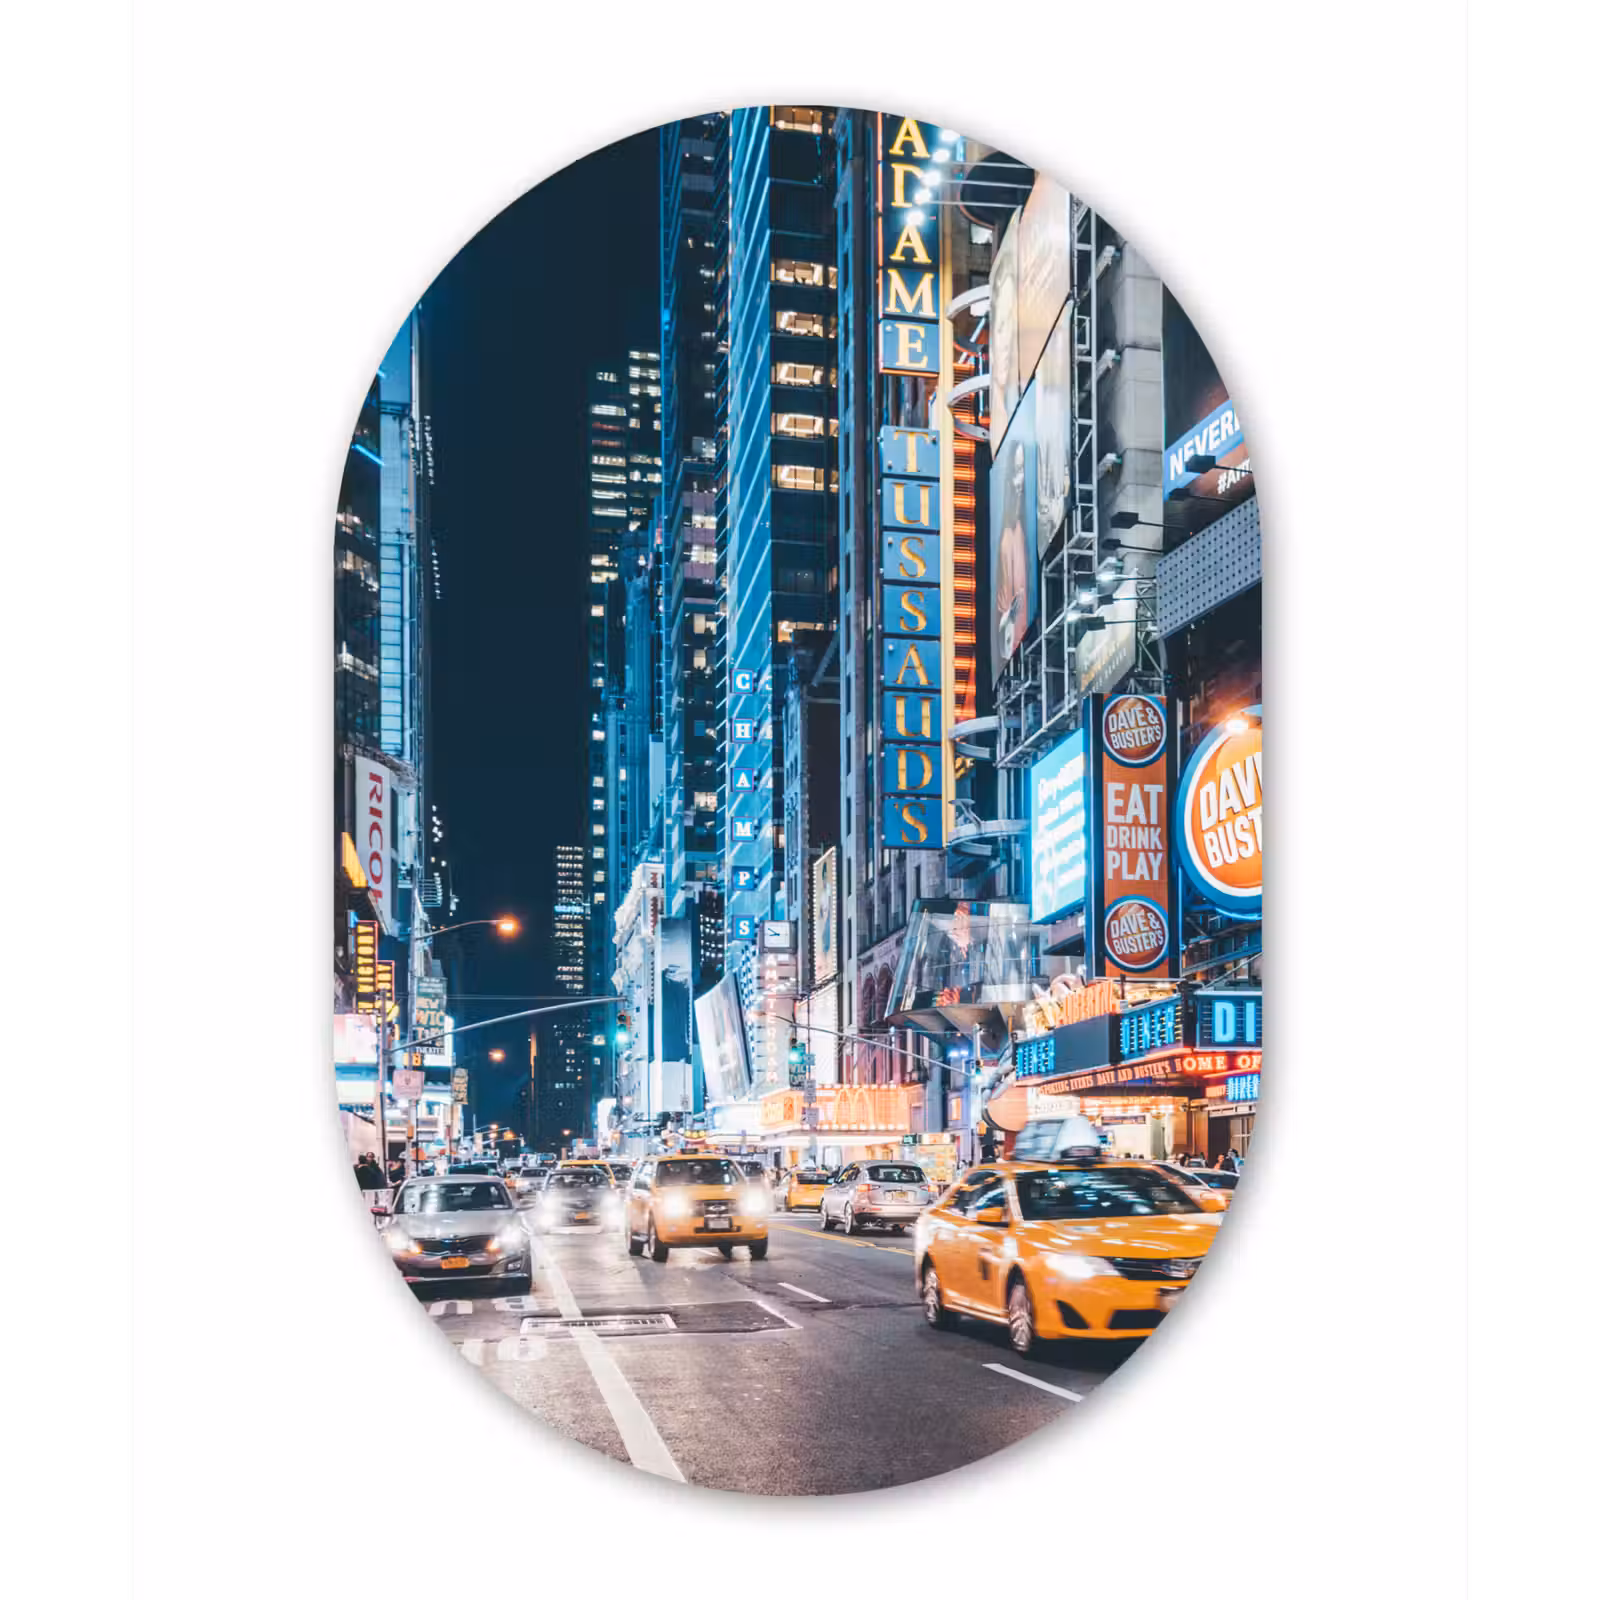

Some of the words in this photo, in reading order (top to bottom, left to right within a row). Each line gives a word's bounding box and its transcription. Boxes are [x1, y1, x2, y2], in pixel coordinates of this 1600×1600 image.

[893, 429, 933, 845] TUSSAUD'S
[1108, 709, 1146, 733] DAVE
[1147, 707, 1160, 726] &
[1110, 724, 1161, 750] BUSTER'S
[733, 671, 754, 938] CHAMPS
[1107, 783, 1163, 825] EAT
[1107, 826, 1162, 850] DRINK
[1107, 851, 1163, 881] PLAY
[1110, 915, 1149, 939] DAVE
[1149, 911, 1161, 930] &
[1112, 930, 1164, 956] BUSTER'S
[765, 954, 778, 1082] AMTERDAM
[1120, 1004, 1176, 1055] DINER
[1117, 1068, 1133, 1081] AND
